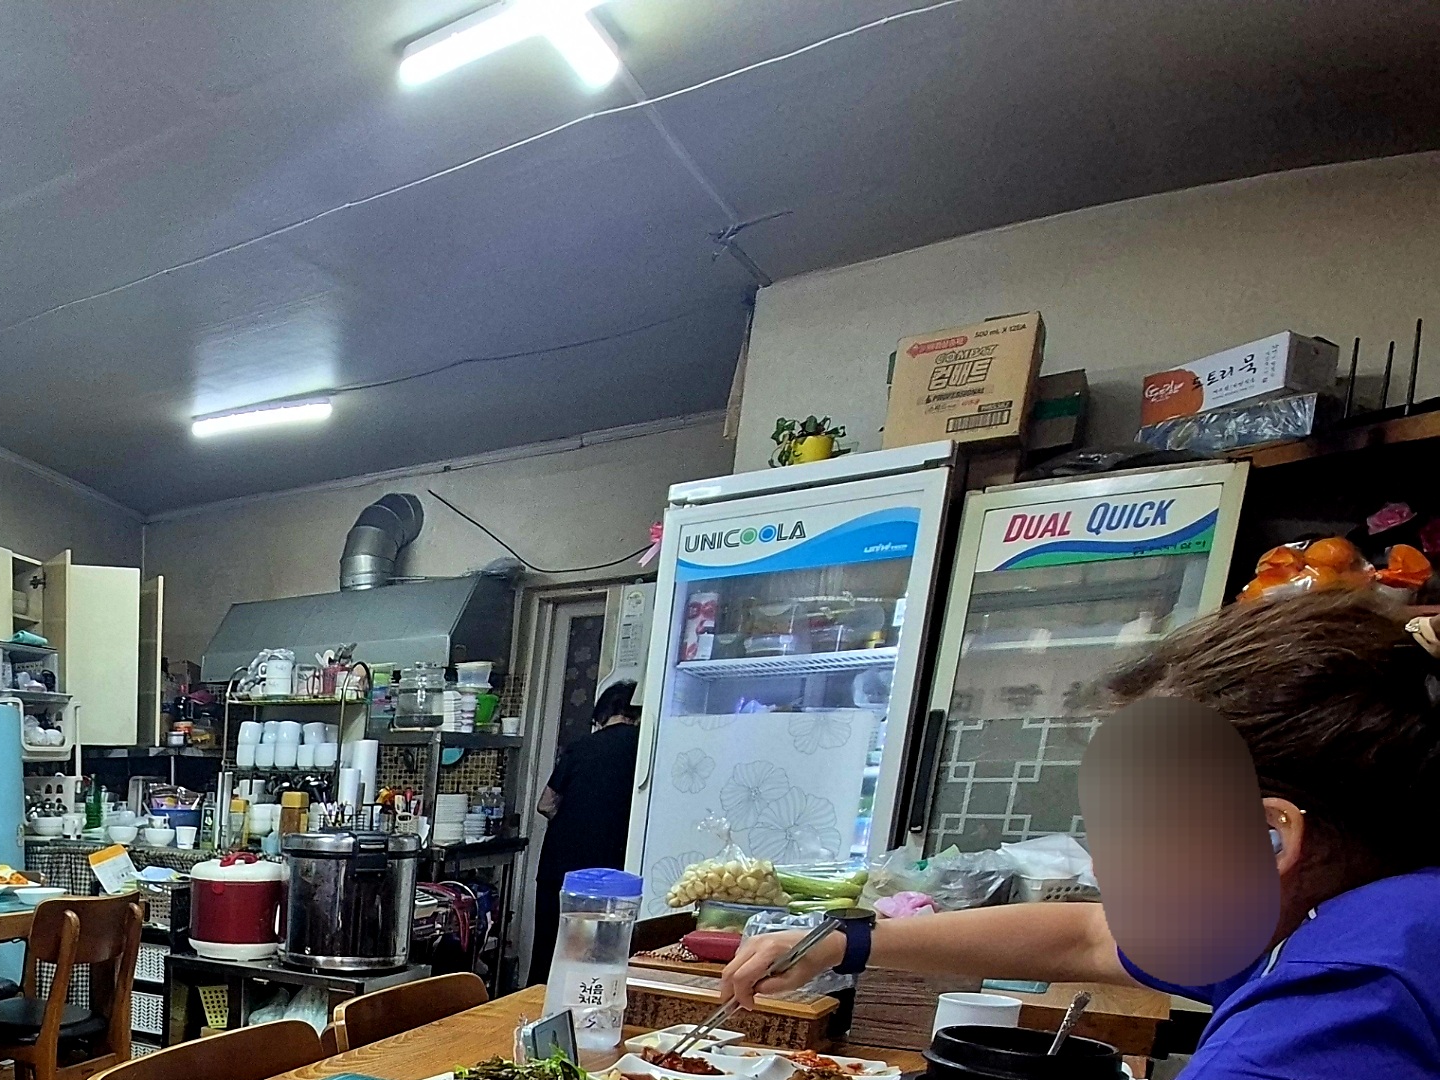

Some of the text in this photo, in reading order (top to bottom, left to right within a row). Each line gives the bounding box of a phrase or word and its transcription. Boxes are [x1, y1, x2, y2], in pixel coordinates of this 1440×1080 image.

[927, 357, 993, 391] 컴배트
[684, 520, 807, 553] UNICOOLA
[1002, 498, 1176, 543] DUAL QUICK
[578, 993, 603, 1005] 처럼
[579, 981, 604, 995] 처음
